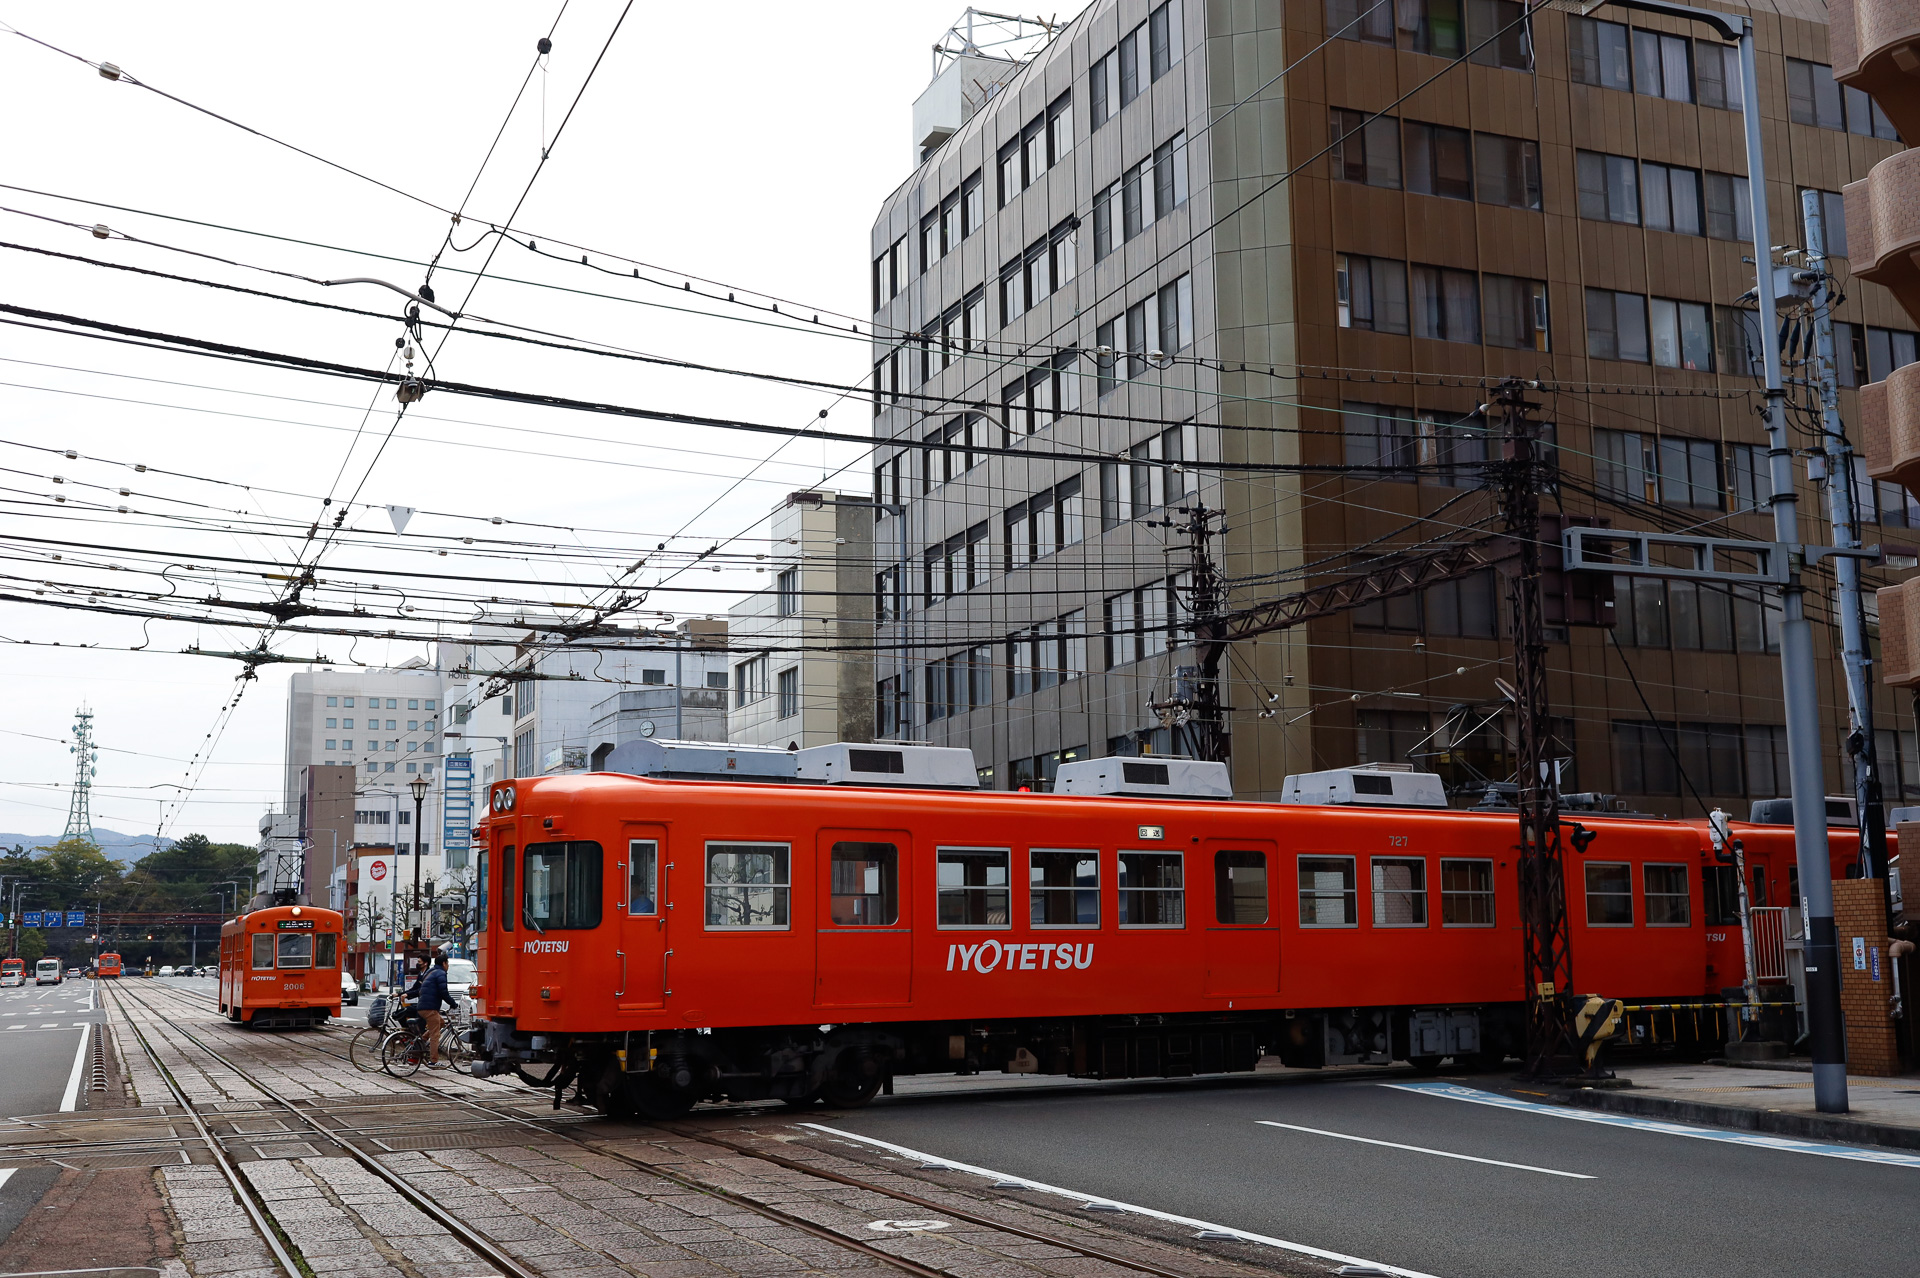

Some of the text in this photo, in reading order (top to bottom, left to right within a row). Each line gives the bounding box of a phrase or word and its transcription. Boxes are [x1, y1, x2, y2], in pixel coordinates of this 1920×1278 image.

[1140, 829, 1161, 837] 回送
[1389, 836, 1408, 847] 727
[523, 940, 569, 954] IYOTETSU
[946, 939, 1094, 974] IYOTETSU
